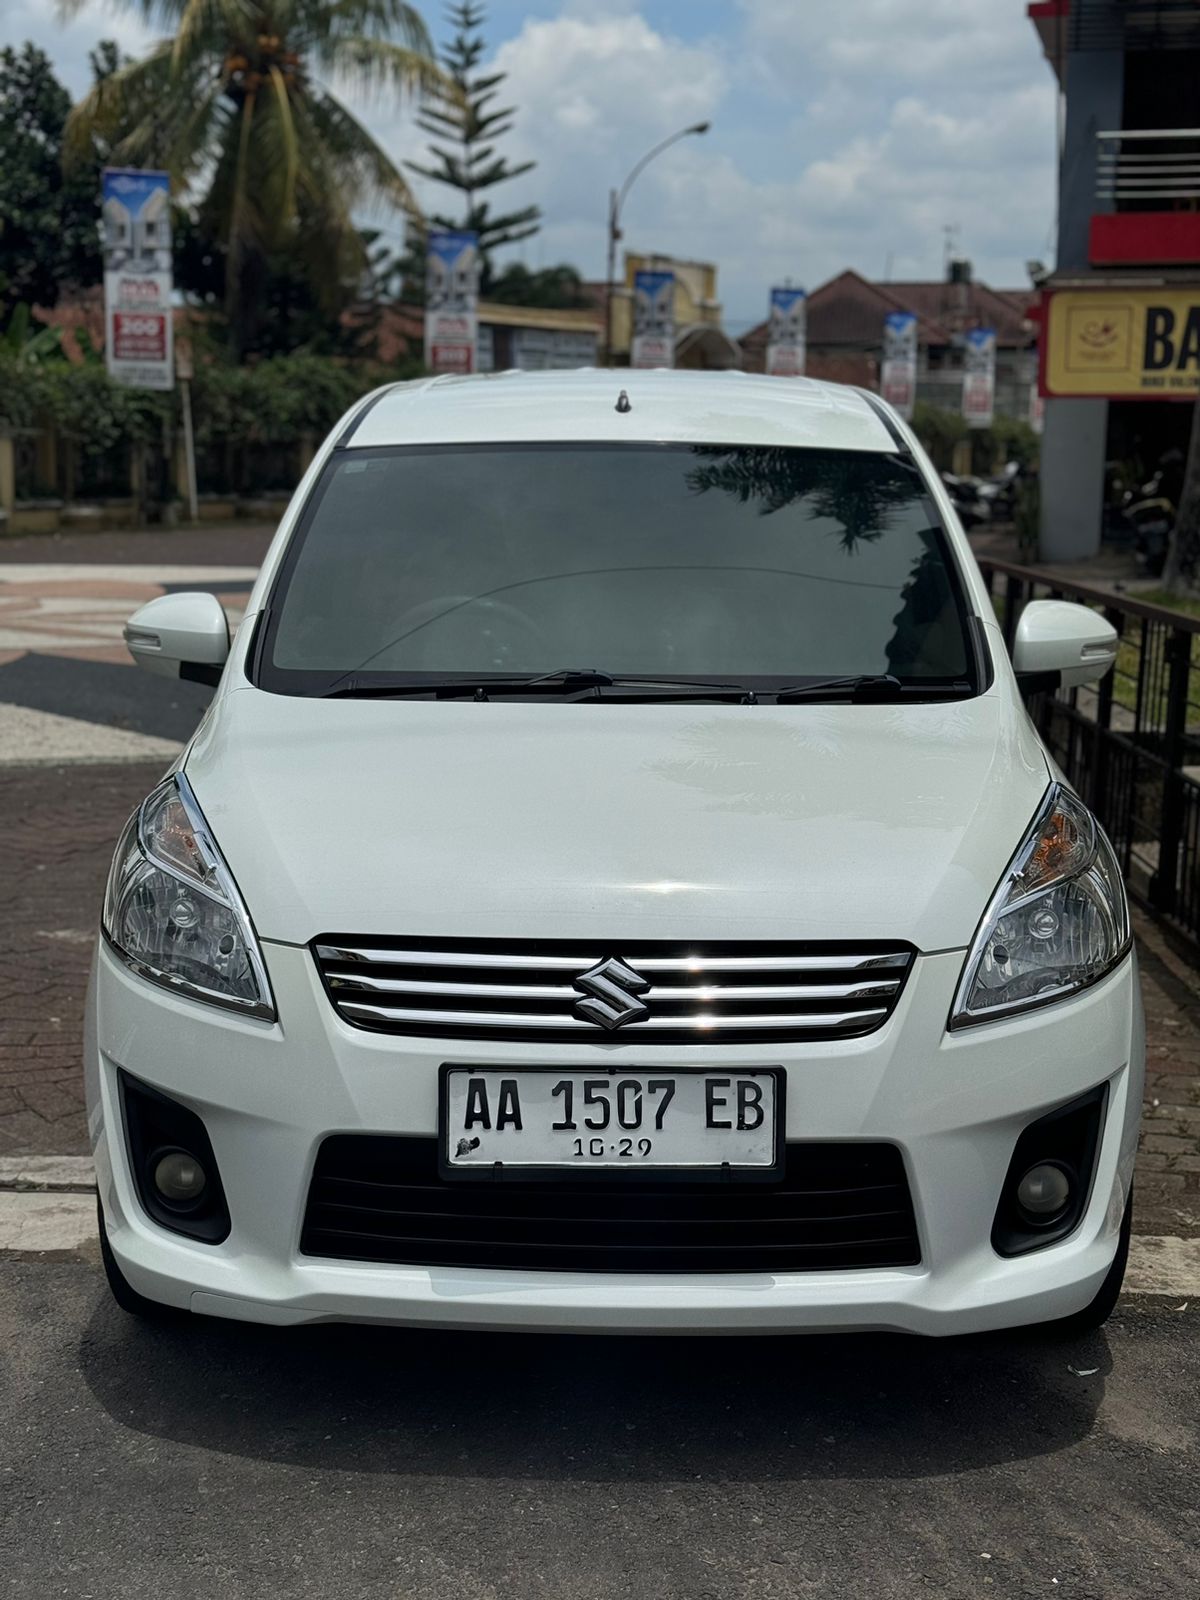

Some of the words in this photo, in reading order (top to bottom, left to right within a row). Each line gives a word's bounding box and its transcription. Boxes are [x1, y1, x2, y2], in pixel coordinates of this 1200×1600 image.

[464, 1078, 523, 1130] AA
[552, 1079, 675, 1130] 1507
[705, 1078, 764, 1130] EB
